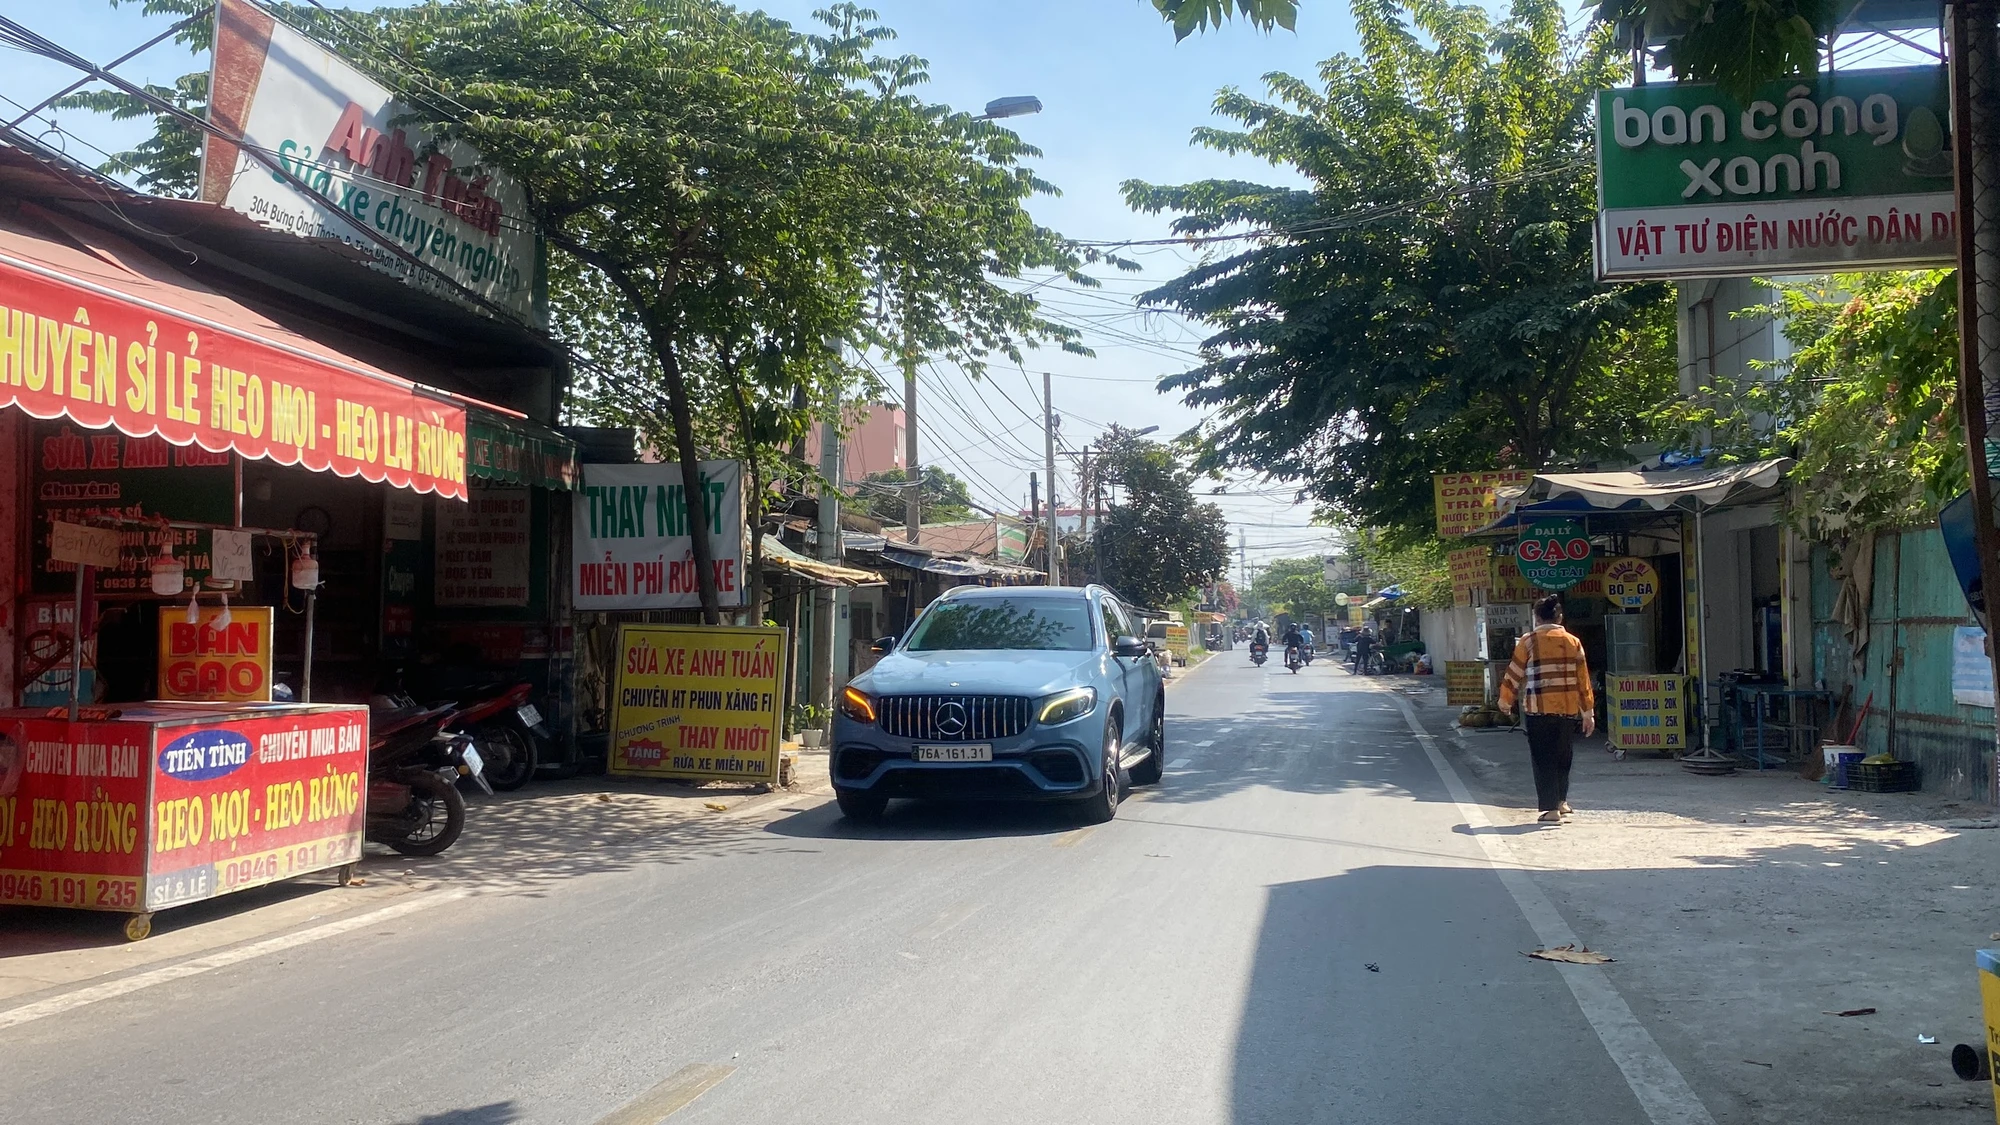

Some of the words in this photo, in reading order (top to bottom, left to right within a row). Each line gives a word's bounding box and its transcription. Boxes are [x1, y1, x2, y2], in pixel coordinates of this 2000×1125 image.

[1613, 96, 1726, 147] ban
[1741, 84, 1899, 146] công
[325, 100, 415, 190] Anh
[1679, 139, 1841, 199] xanh
[249, 195, 270, 217] 304
[269, 204, 295, 231] Bưng
[339, 180, 369, 223] xe
[375, 194, 457, 262] chuyên
[1617, 219, 1665, 261] VẬT
[1675, 218, 1711, 253] TƯ
[1717, 213, 1778, 257] ĐIỆN
[1788, 209, 1858, 250] NƯỚC
[1867, 206, 1922, 244] DÂN
[125, 320, 158, 415] SỈ
[166, 331, 201, 425] LẺ
[210, 363, 264, 439] HEO
[336, 398, 379, 463] HEO
[383, 411, 413, 471] LAI
[417, 411, 465, 485] RỪNG
[42, 426, 87, 471] SỬA
[89, 435, 119, 470] XE
[587, 486, 648, 538] THAY
[580, 551, 627, 596] MIỄN
[633, 554, 663, 595] PHÍ
[712, 559, 735, 592] XE
[1518, 538, 1591, 567] GẠO
[168, 614, 260, 657] BÁN
[628, 638, 659, 675] SỬA
[664, 648, 685, 676] XE
[689, 649, 726, 677] ANH
[732, 638, 775, 679] TUẤN
[165, 660, 264, 701] GẠO
[623, 685, 668, 708] CHUYÊN
[672, 689, 687, 708] HT
[690, 690, 722, 710] PHUN
[726, 688, 758, 712] XĂNG
[762, 693, 772, 712] FI
[1663, 680, 1677, 692] 15K
[26, 736, 72, 776] CHUYÊN
[75, 743, 107, 776] MUA
[111, 738, 139, 778] BÁN
[166, 738, 205, 773] TIẾN
[208, 739, 247, 768] TÌNH
[259, 725, 307, 765] CHUYÊN
[310, 727, 336, 757] MUA
[339, 719, 362, 754] BÁN
[679, 725, 719, 749] THAY
[724, 723, 770, 751] NHỚT
[919, 748, 985, 760] 76A-161.31
[673, 753, 695, 770] RỬA
[699, 757, 712, 770] XE
[715, 756, 744, 773] MIỄN
[747, 758, 766, 773] PHÍ
[29, 798, 68, 851] HEO
[74, 786, 138, 855] RỪNG
[155, 795, 205, 854] HEO
[208, 788, 251, 853] MỌI
[264, 780, 306, 832] HEO
[308, 762, 360, 823] RỪNG
[173, 881, 185, 900] &
[189, 870, 207, 898] LẺ
[225, 853, 279, 888] 0946
[286, 844, 320, 873] 191
[50, 877, 86, 904] 191
[96, 879, 138, 908] 235
